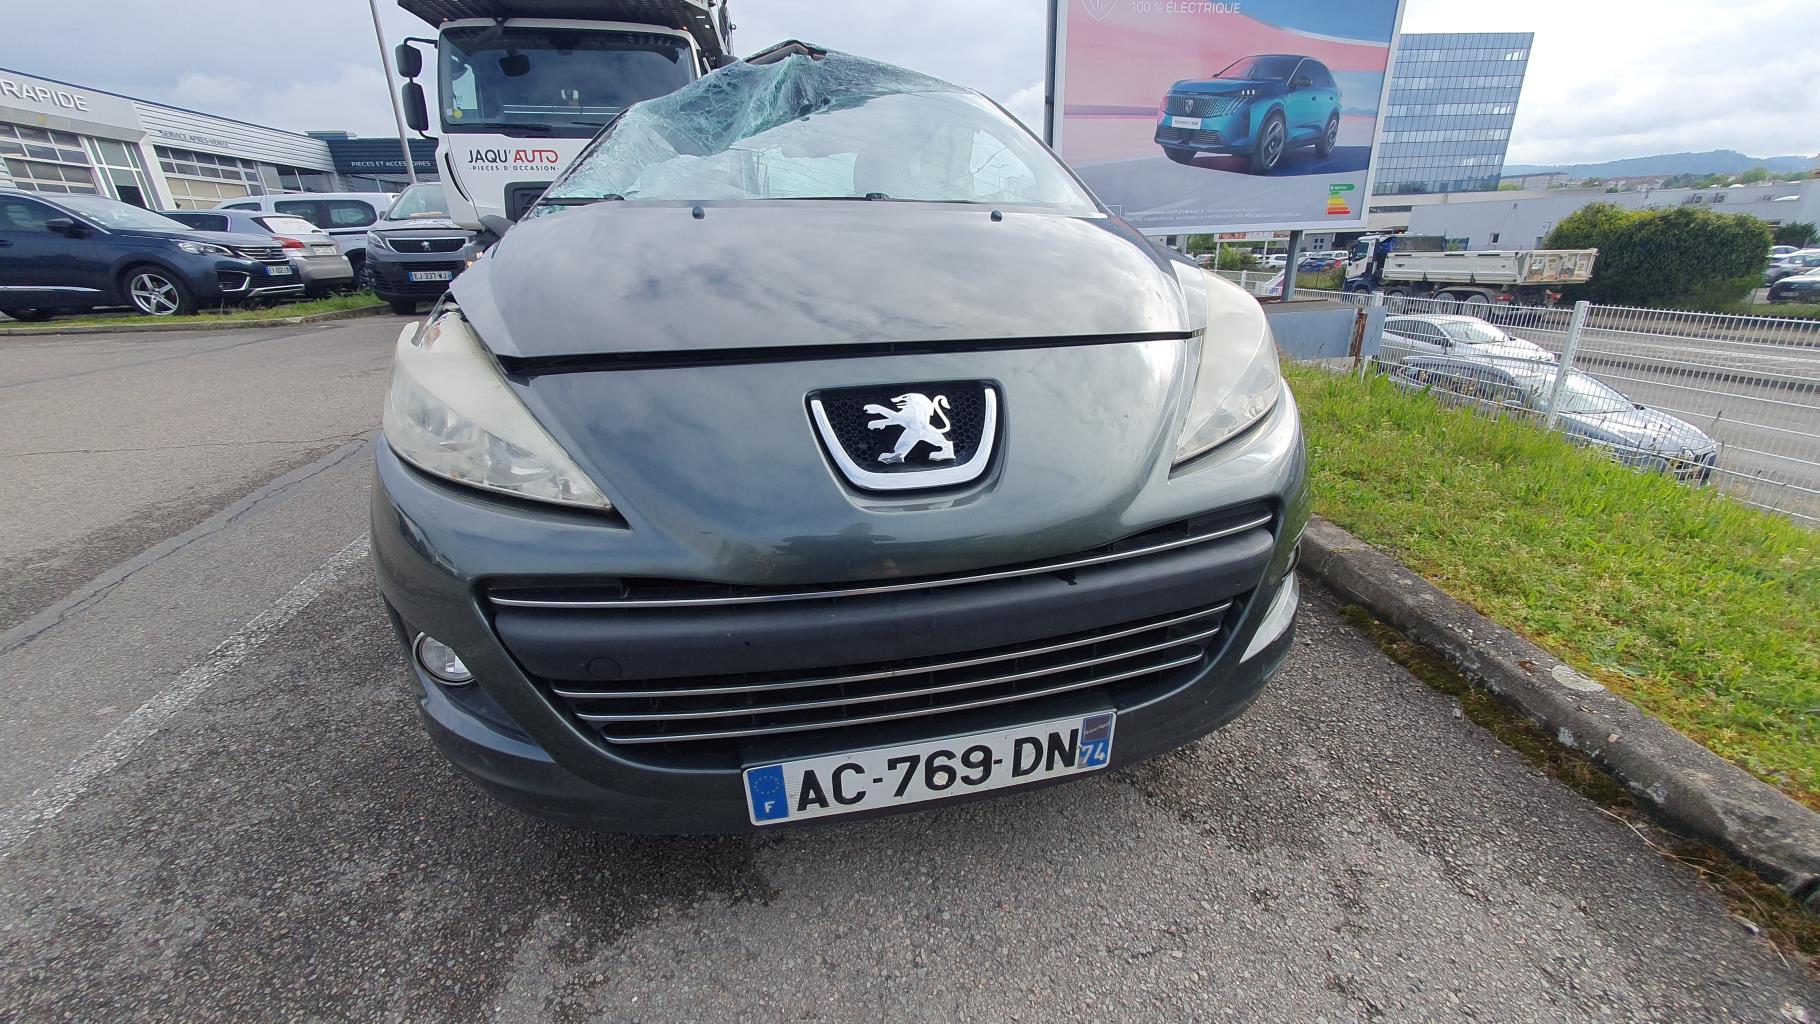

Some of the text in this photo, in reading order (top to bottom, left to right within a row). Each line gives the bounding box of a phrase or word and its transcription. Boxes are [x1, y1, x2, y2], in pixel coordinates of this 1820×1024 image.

[1132, 2, 1151, 13] 100
[0, 80, 91, 112] RAPIDE
[1081, 742, 1107, 765] 74
[797, 728, 1080, 811] AC-769-DN
[764, 801, 773, 815] F
